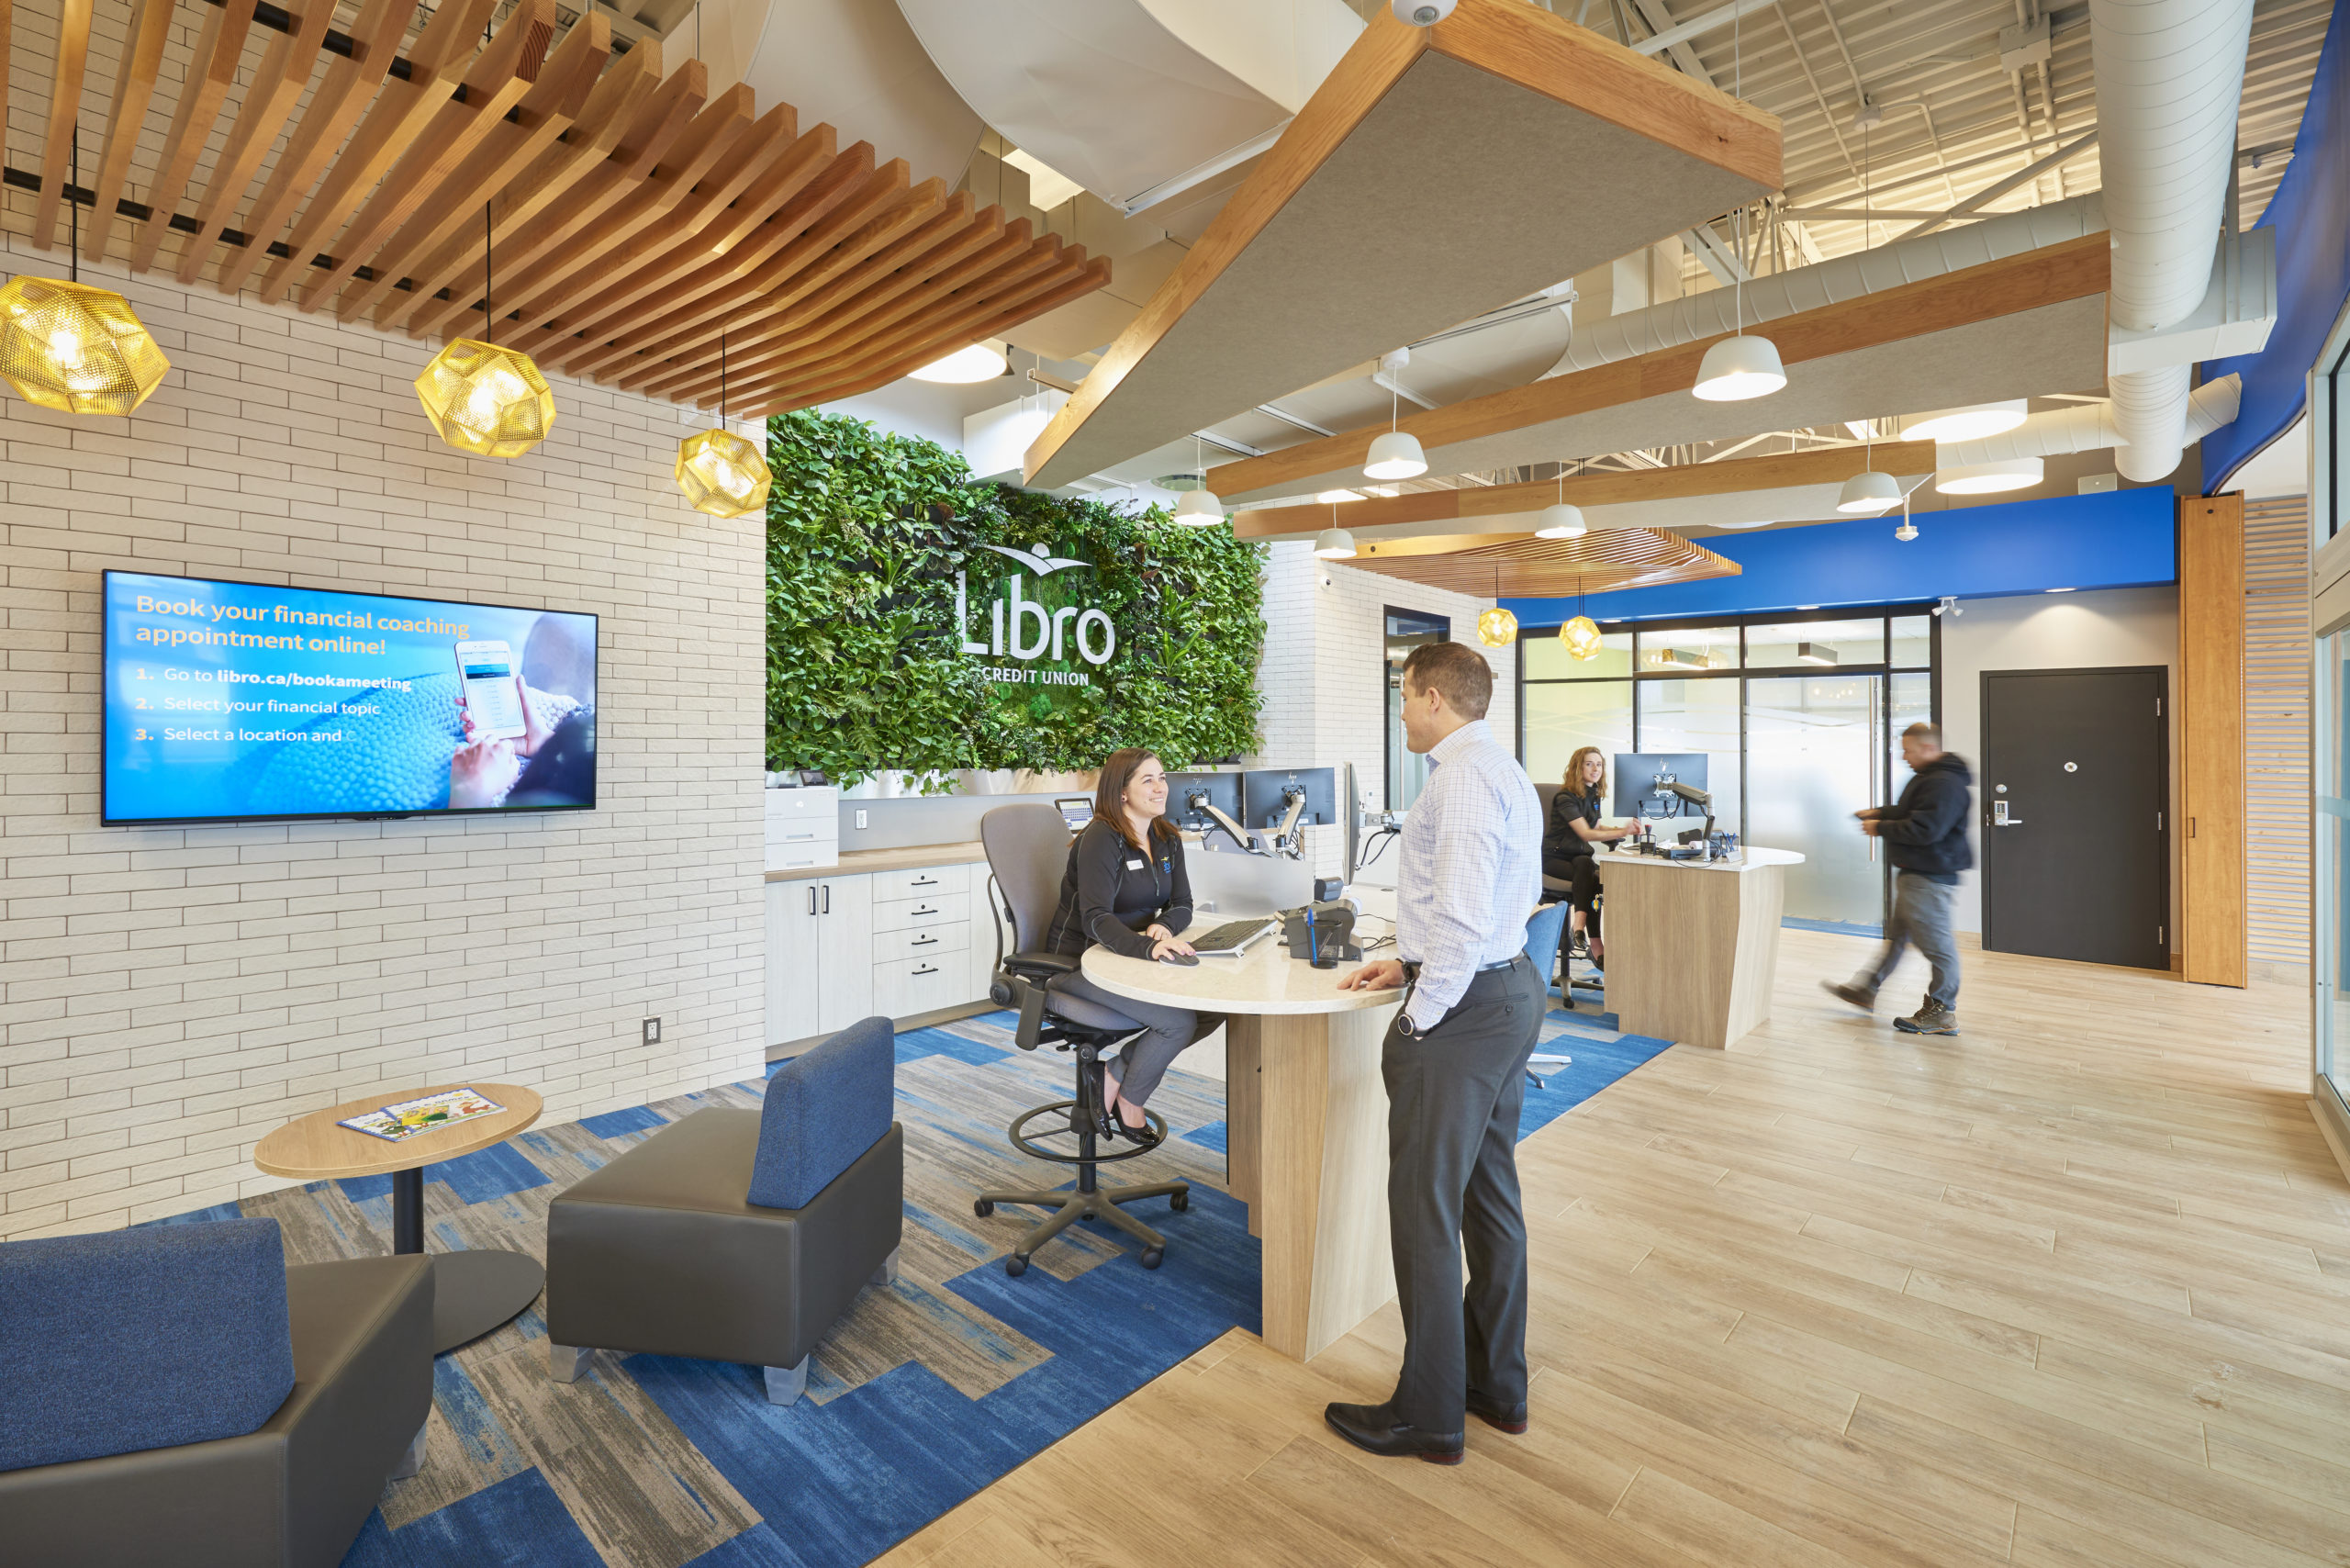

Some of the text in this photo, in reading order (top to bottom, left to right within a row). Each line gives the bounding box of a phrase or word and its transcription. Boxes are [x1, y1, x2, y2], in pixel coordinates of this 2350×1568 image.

[137, 596, 470, 640] Book your financial coaching
[956, 570, 1115, 665] Libro
[136, 627, 386, 655] appointment online!
[136, 667, 412, 692] 1. Go to libro.ca/bookameeting
[982, 666, 1089, 686] CREDIT UNION
[135, 697, 381, 717] 2. Select your financial topic
[135, 728, 154, 741] 3.
[164, 727, 220, 741] Select
[224, 731, 234, 741] a
[239, 728, 308, 742] location
[311, 729, 341, 742] and
